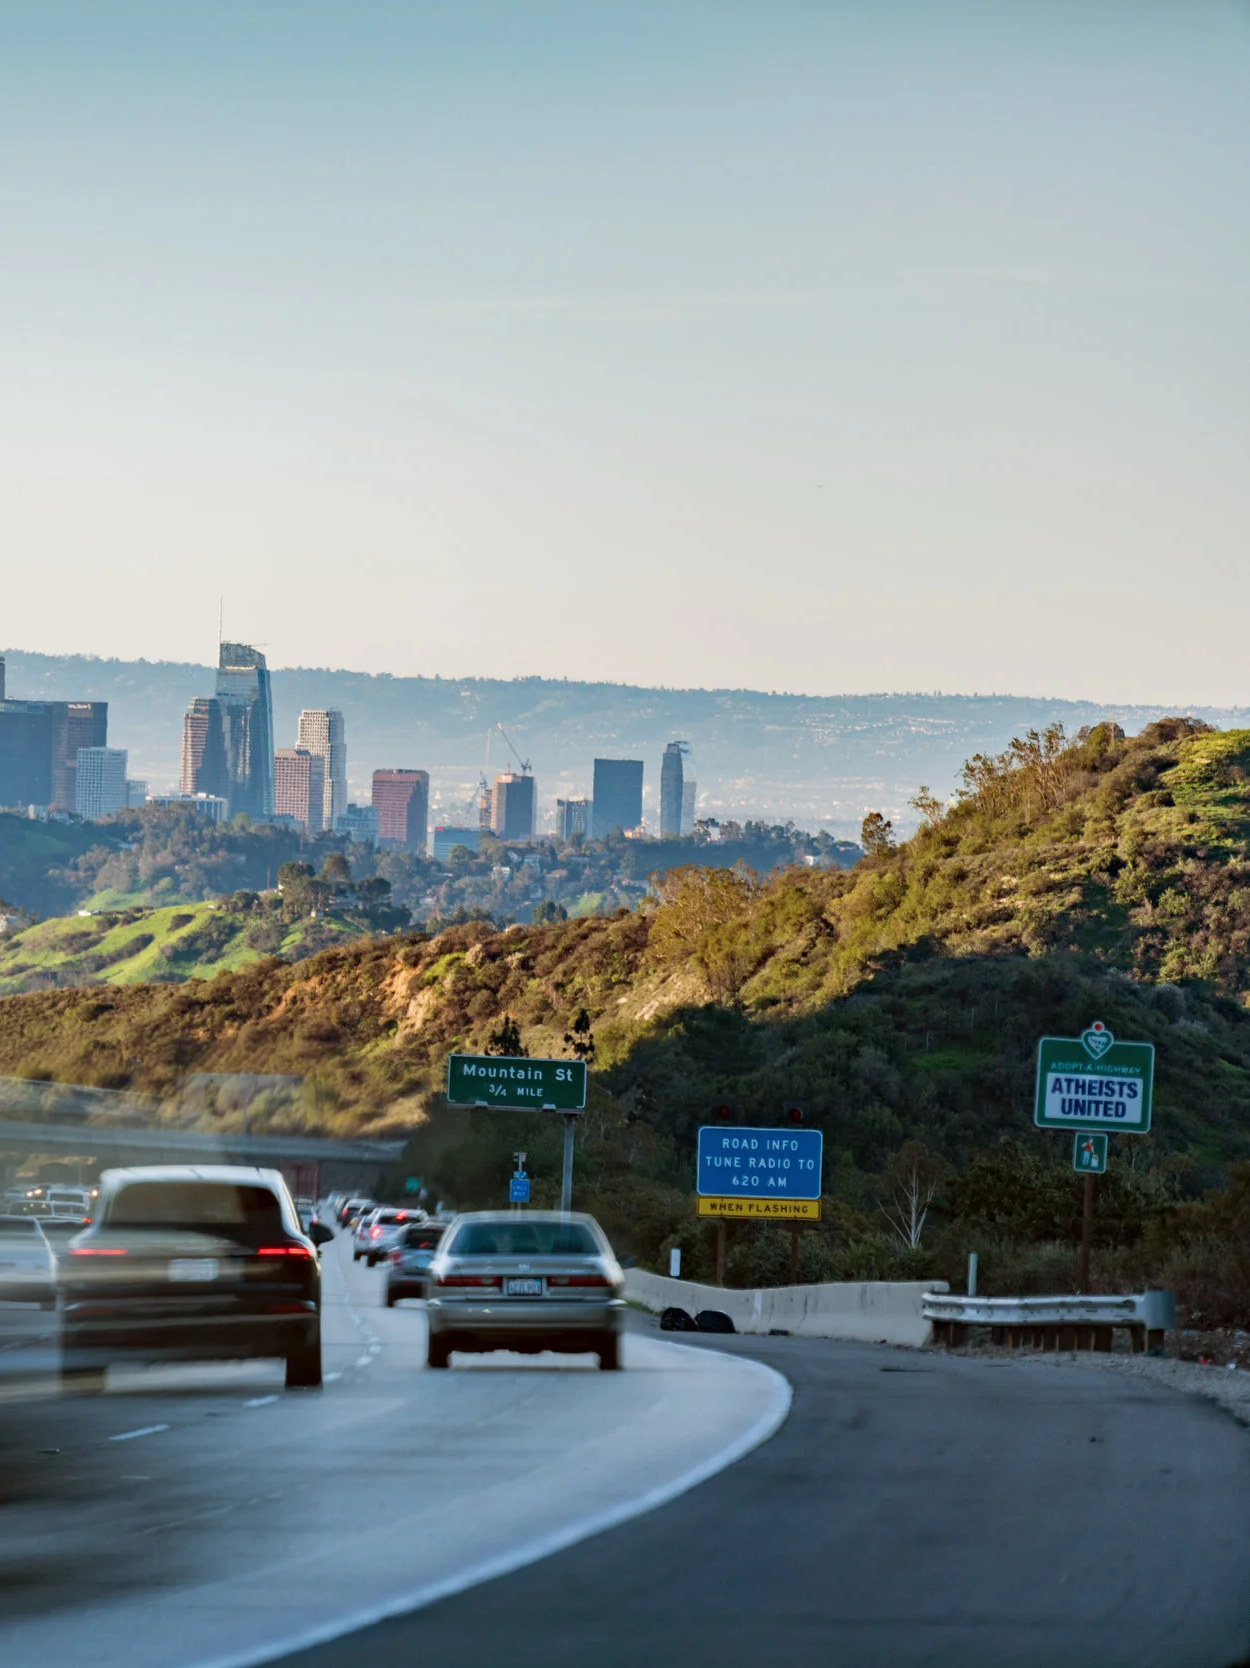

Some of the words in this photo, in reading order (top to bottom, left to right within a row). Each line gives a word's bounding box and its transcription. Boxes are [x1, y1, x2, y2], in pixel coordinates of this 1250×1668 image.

[463, 1063, 543, 1080] Mountain
[555, 1068, 573, 1082] St
[1051, 1062, 1142, 1075] ADOPT-A-HIGHWAY
[489, 1084, 507, 1096] 3/4
[517, 1087, 543, 1097] MILE
[1051, 1077, 1138, 1099] ATHEISTS
[1061, 1098, 1127, 1118] UNITED
[722, 1138, 759, 1150] ROAD
[766, 1139, 799, 1151] INFO
[705, 1156, 741, 1168] TUNE
[749, 1157, 791, 1169] RADIO
[798, 1159, 815, 1170] TO
[732, 1175, 759, 1187] 620
[767, 1176, 787, 1188] AM
[710, 1202, 743, 1212] WHEN
[748, 1203, 809, 1214] FLASHING
